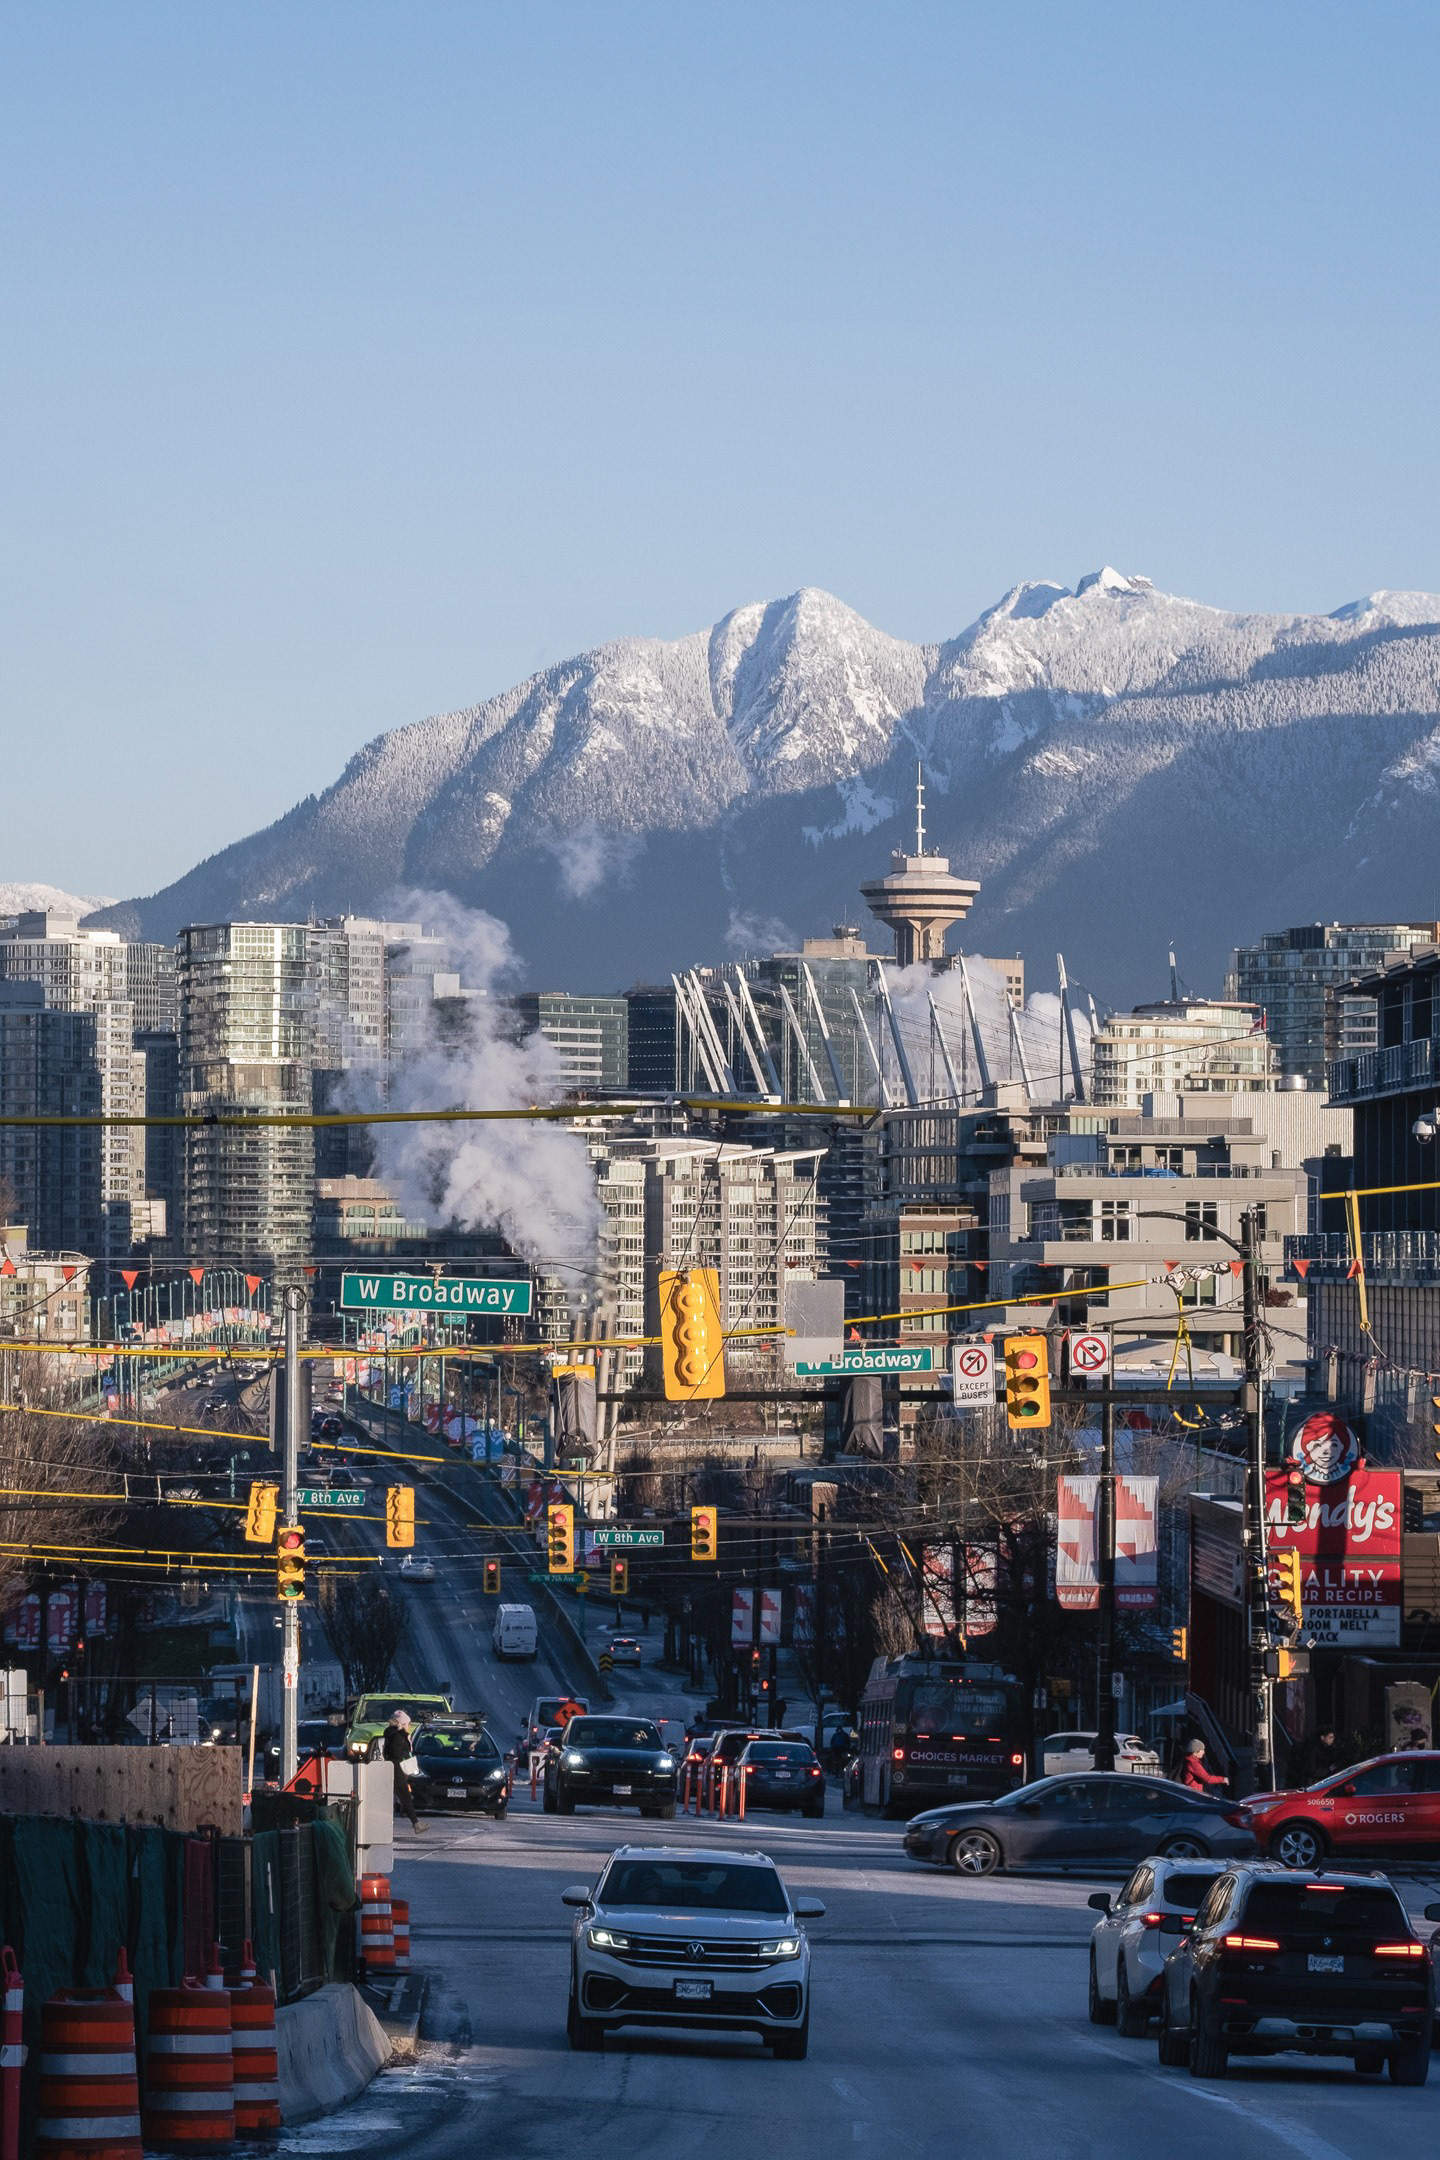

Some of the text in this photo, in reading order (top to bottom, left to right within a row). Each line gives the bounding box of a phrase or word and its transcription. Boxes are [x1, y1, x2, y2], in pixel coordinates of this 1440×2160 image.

[358, 1278, 515, 1311] W Broadway
[831, 1352, 922, 1369] Broadway
[959, 1382, 990, 1391] EXCEPT
[961, 1390, 989, 1400] BUSES
[311, 1492, 332, 1503] 8th
[337, 1492, 360, 1504] Ave
[599, 1533, 660, 1543] W 8th Ave
[1267, 1569, 1384, 1589] QALITY
[1301, 1590, 1319, 1601] UR
[1325, 1590, 1383, 1602] RECIPE
[1309, 1608, 1380, 1619] PORTABELLA
[1269, 1620, 1369, 1632] MROOM MELT
[1311, 1631, 1339, 1642] BACK
[910, 1751, 1004, 1764] CHOICES MARKET
[1359, 1813, 1405, 1823] ROGERS
